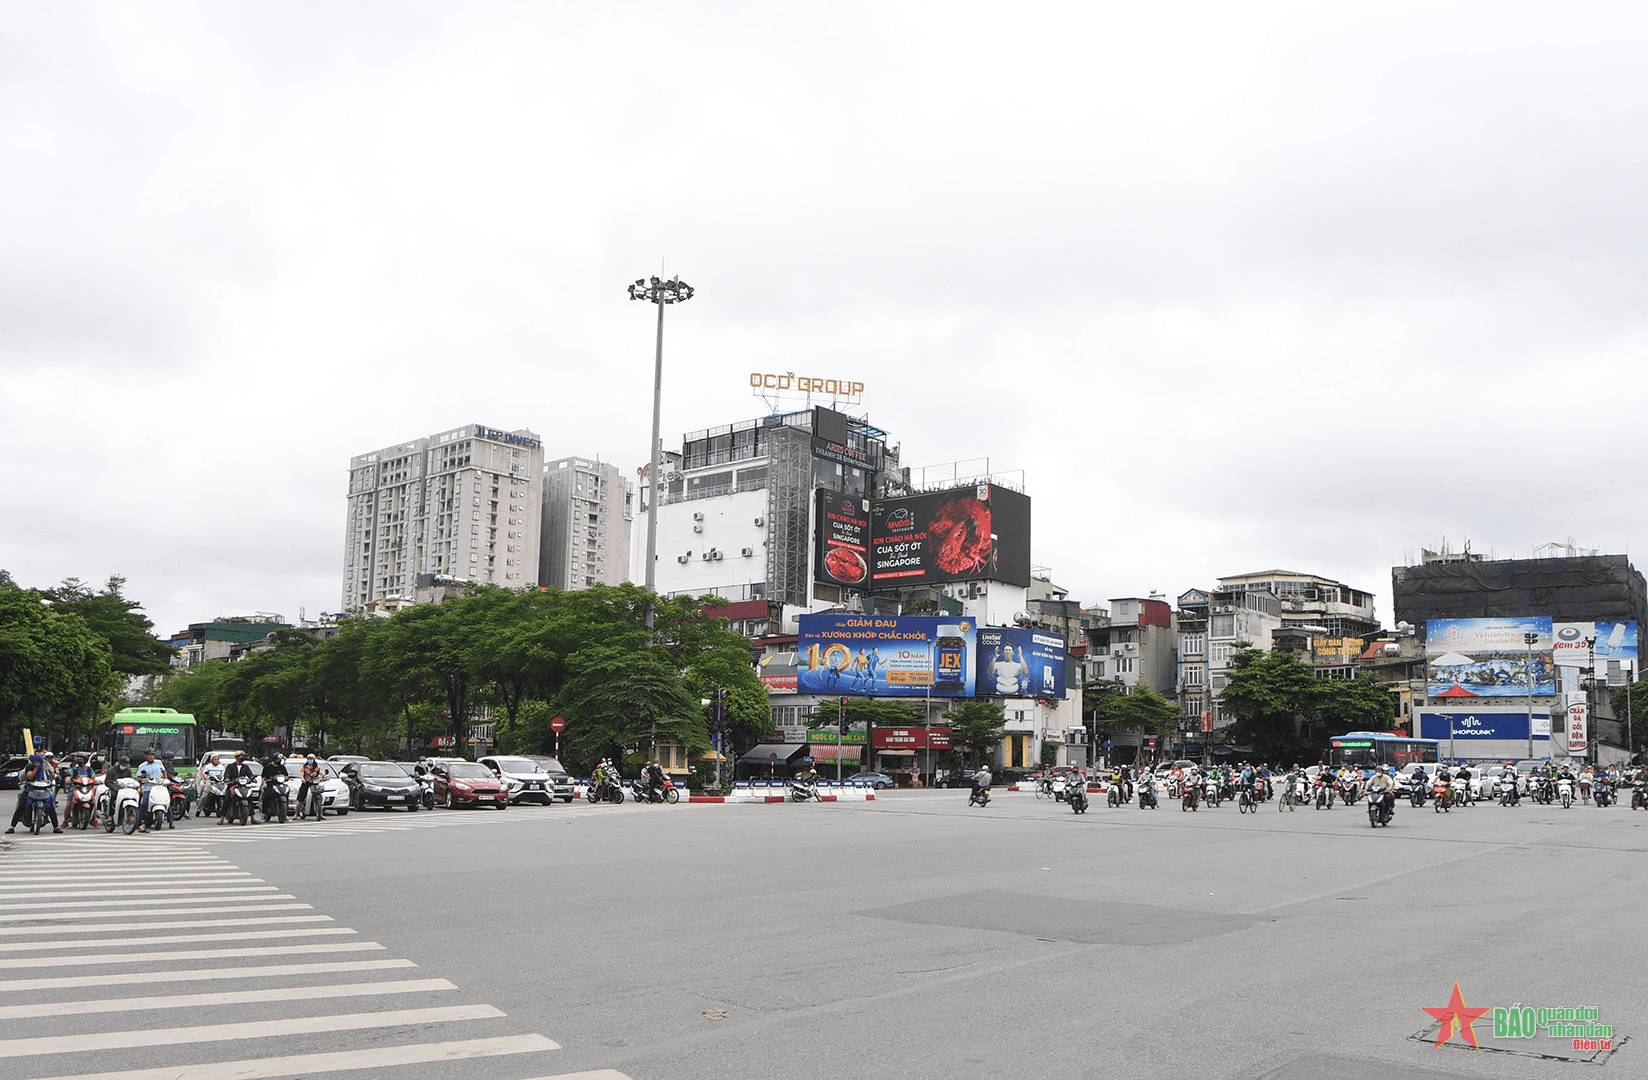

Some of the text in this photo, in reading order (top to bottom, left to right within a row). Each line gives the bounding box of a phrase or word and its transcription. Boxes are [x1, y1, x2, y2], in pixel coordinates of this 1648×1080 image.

[750, 373, 864, 395] OCD GROUP
[833, 533, 860, 545] SINGAPORE
[873, 532, 927, 545] XIN CHÀO HÀ NỘI
[877, 541, 922, 554] CUA SỐT ỚT
[877, 557, 921, 569] SINGAPORE
[847, 617, 873, 628] GIẢM
[874, 619, 897, 628] ĐAU
[821, 631, 851, 639] XƯƠNG
[853, 630, 877, 639] KHỚP
[878, 630, 902, 639] CHẮC
[902, 630, 927, 640] KHỎE
[805, 643, 852, 672] 10
[898, 650, 911, 659] 10
[939, 653, 961, 668] JEX
[811, 733, 828, 741] NƯỚC
[828, 733, 838, 741] ÉP
